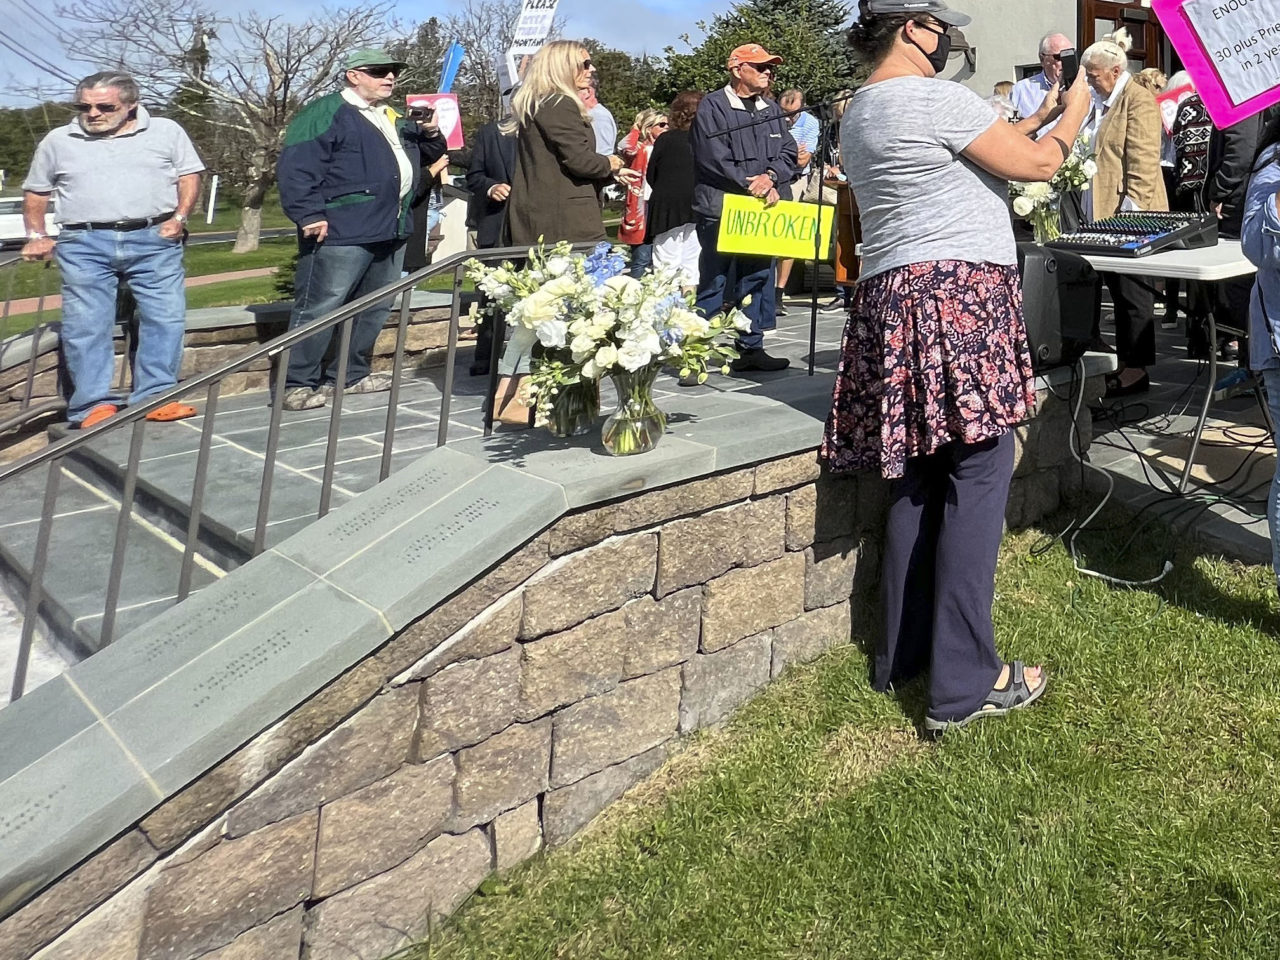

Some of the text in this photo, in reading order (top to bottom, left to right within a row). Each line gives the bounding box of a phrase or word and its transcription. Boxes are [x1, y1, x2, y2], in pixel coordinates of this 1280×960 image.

[525, 0, 557, 10] PLEASE
[1214, 47, 1232, 62] 30
[1233, 35, 1258, 55] plus
[1240, 60, 1252, 71] in
[1253, 53, 1263, 65] 2
[726, 208, 818, 241] UNBROKEN
